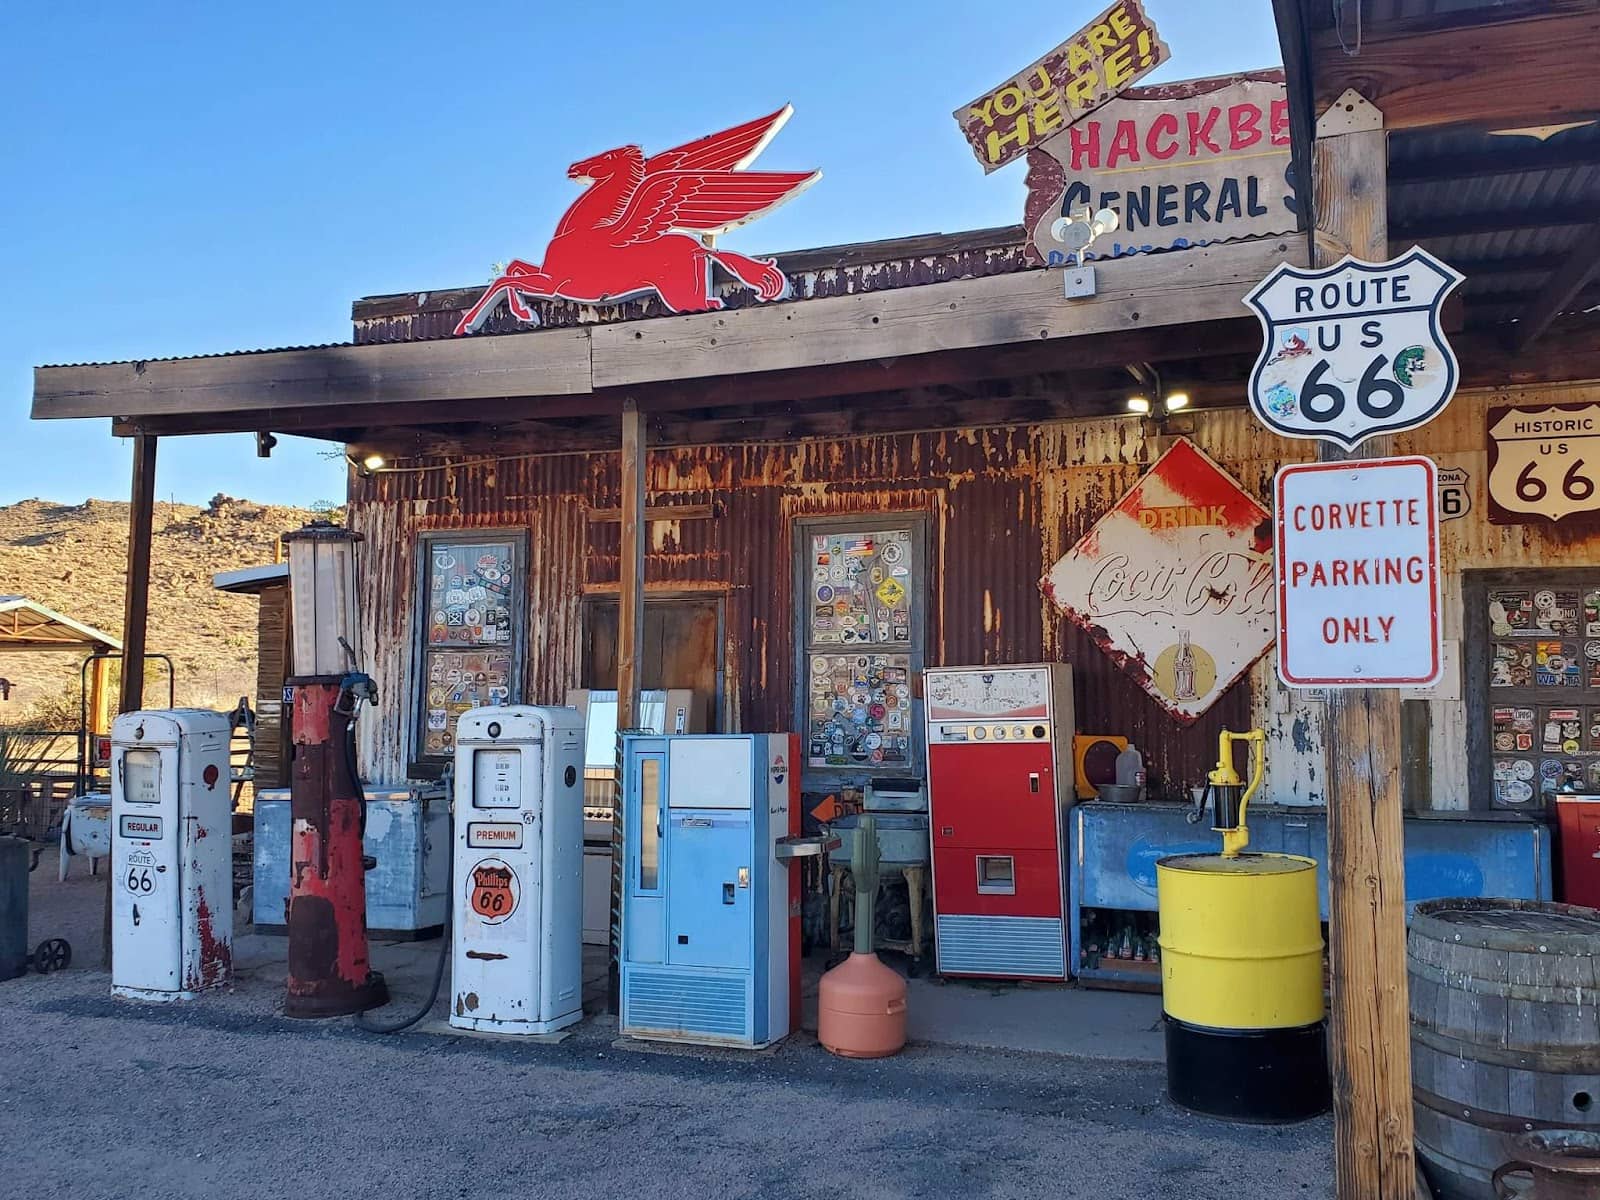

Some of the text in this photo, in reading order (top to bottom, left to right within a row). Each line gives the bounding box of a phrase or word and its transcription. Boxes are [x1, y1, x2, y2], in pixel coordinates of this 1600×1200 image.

[970, 7, 1137, 127] YOU ARE
[984, 30, 1152, 163] HERE!
[1294, 275, 1411, 312] ROUTE
[1299, 353, 1405, 423] 66
[1514, 418, 1593, 433] HISTORIC
[1438, 473, 1461, 482] ZONA
[1515, 458, 1595, 503] 66
[1138, 504, 1229, 530] DRINK
[1293, 499, 1420, 533] CORVETTE
[1291, 556, 1424, 588] PARKING
[1322, 615, 1396, 645] ONLY
[127, 822, 158, 833] REGULAR
[476, 830, 516, 841] PREMIUM
[128, 854, 151, 865] ROUTE
[128, 867, 152, 892] 66
[476, 870, 509, 889] Phillips
[480, 891, 505, 912] 66
